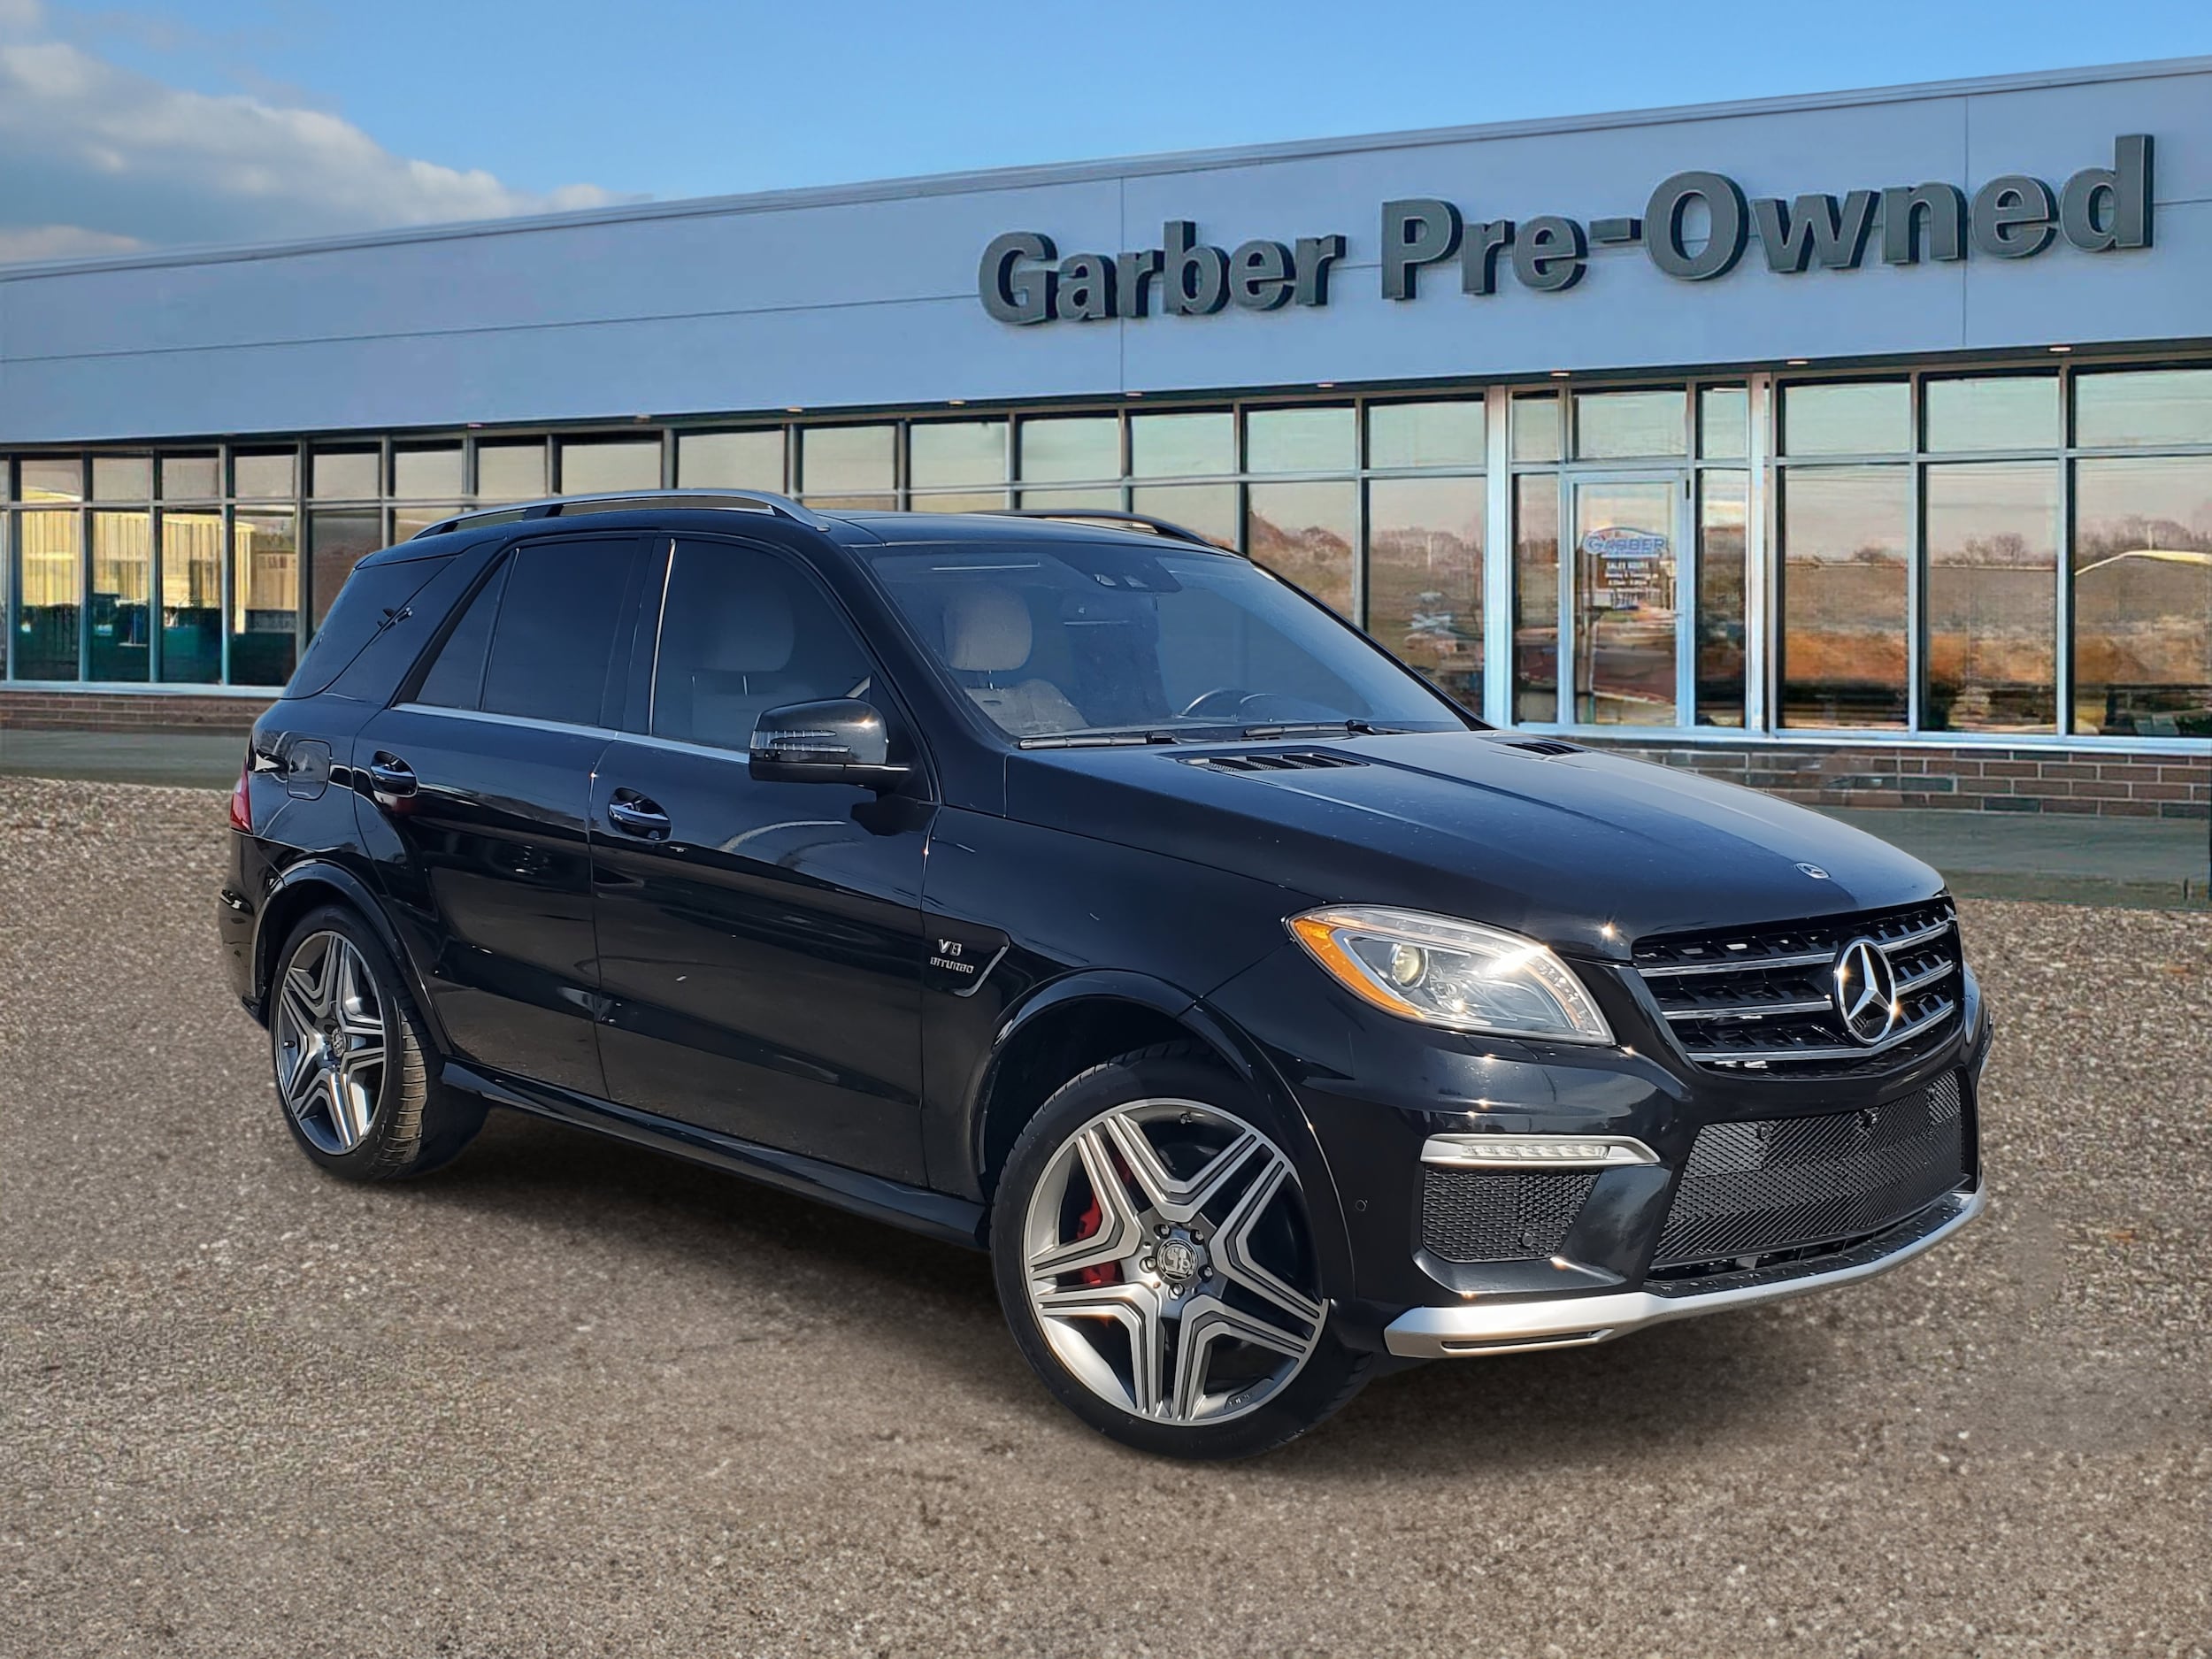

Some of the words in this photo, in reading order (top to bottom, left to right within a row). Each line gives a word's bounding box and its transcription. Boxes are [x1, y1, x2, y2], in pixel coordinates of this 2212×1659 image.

[978, 220, 1346, 325] Garber
[1380, 134, 2154, 301] Pre-Owned
[938, 939, 962, 956] V8
[930, 956, 974, 973] BITURBO
